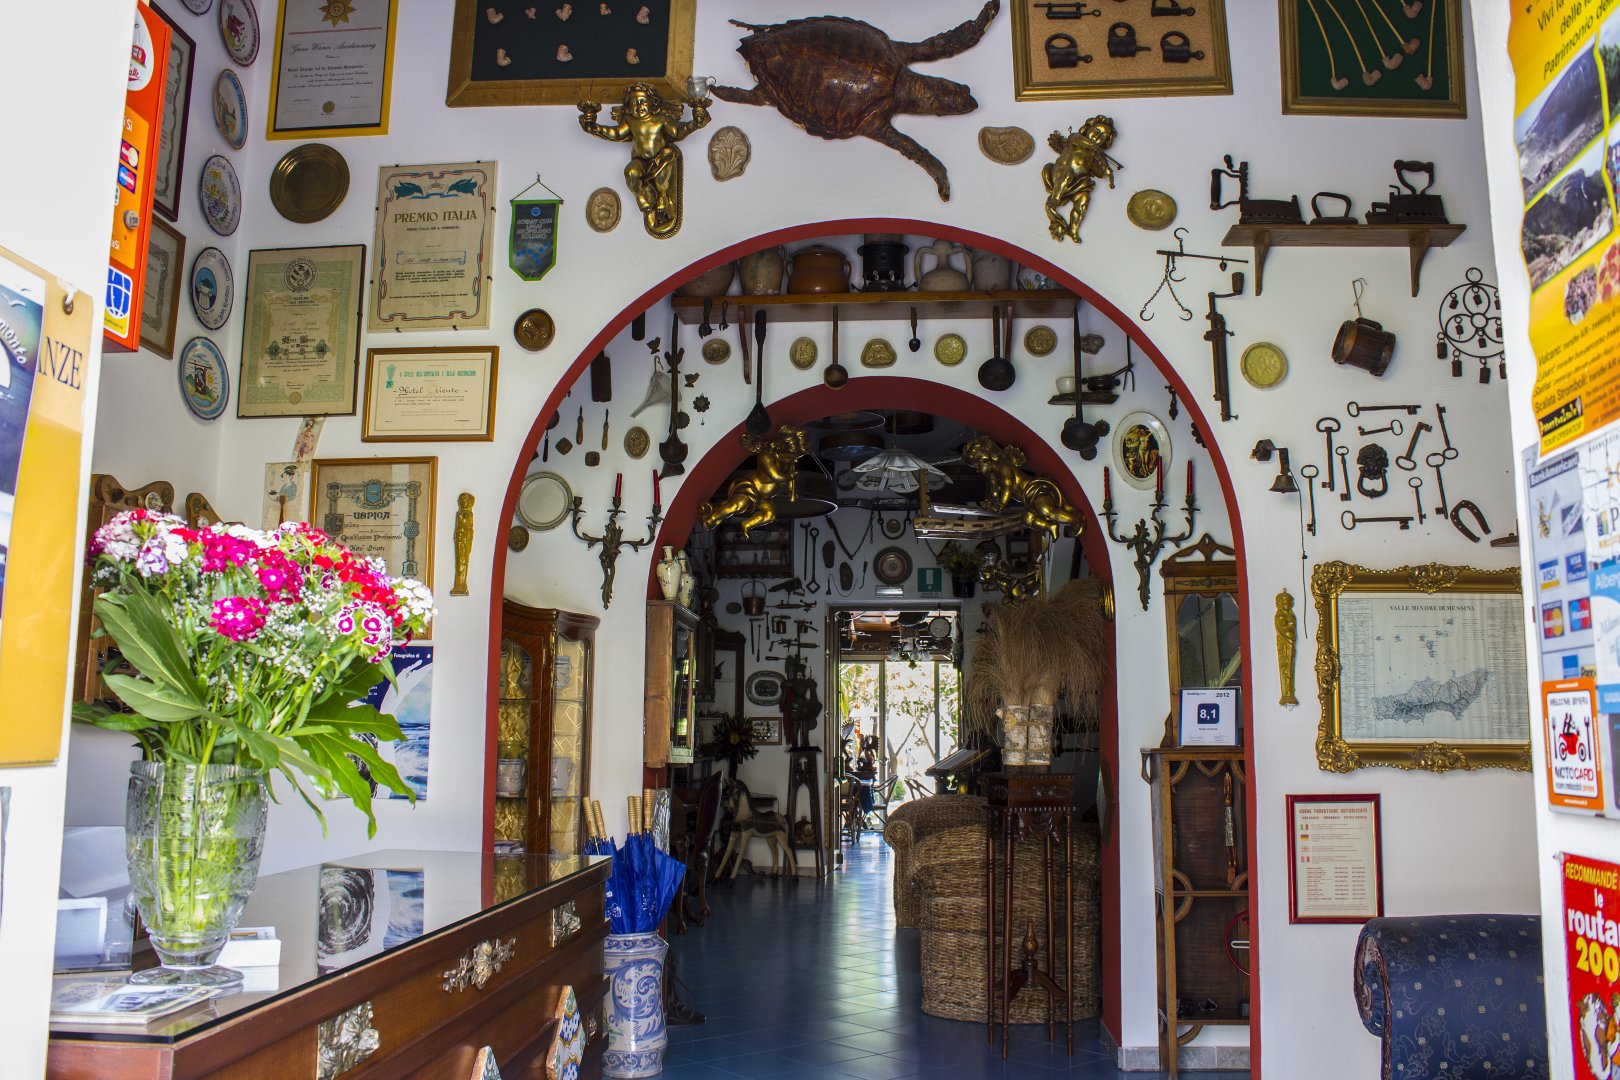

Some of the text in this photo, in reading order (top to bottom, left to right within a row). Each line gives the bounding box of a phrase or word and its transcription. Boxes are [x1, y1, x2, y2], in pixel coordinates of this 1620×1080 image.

[1561, 2, 1582, 35] delle
[1544, 15, 1594, 80] Patrimonio
[394, 210, 477, 223] PREMIO ITALIA
[398, 386, 424, 397] Hotel
[1543, 568, 1556, 582] VISA
[1199, 708, 1216, 720] 8,1
[1565, 862, 1618, 891] RECOMMANDÉ
[1593, 887, 1604, 909] le
[1567, 907, 1620, 949] routa
[1575, 936, 1620, 984] 200
